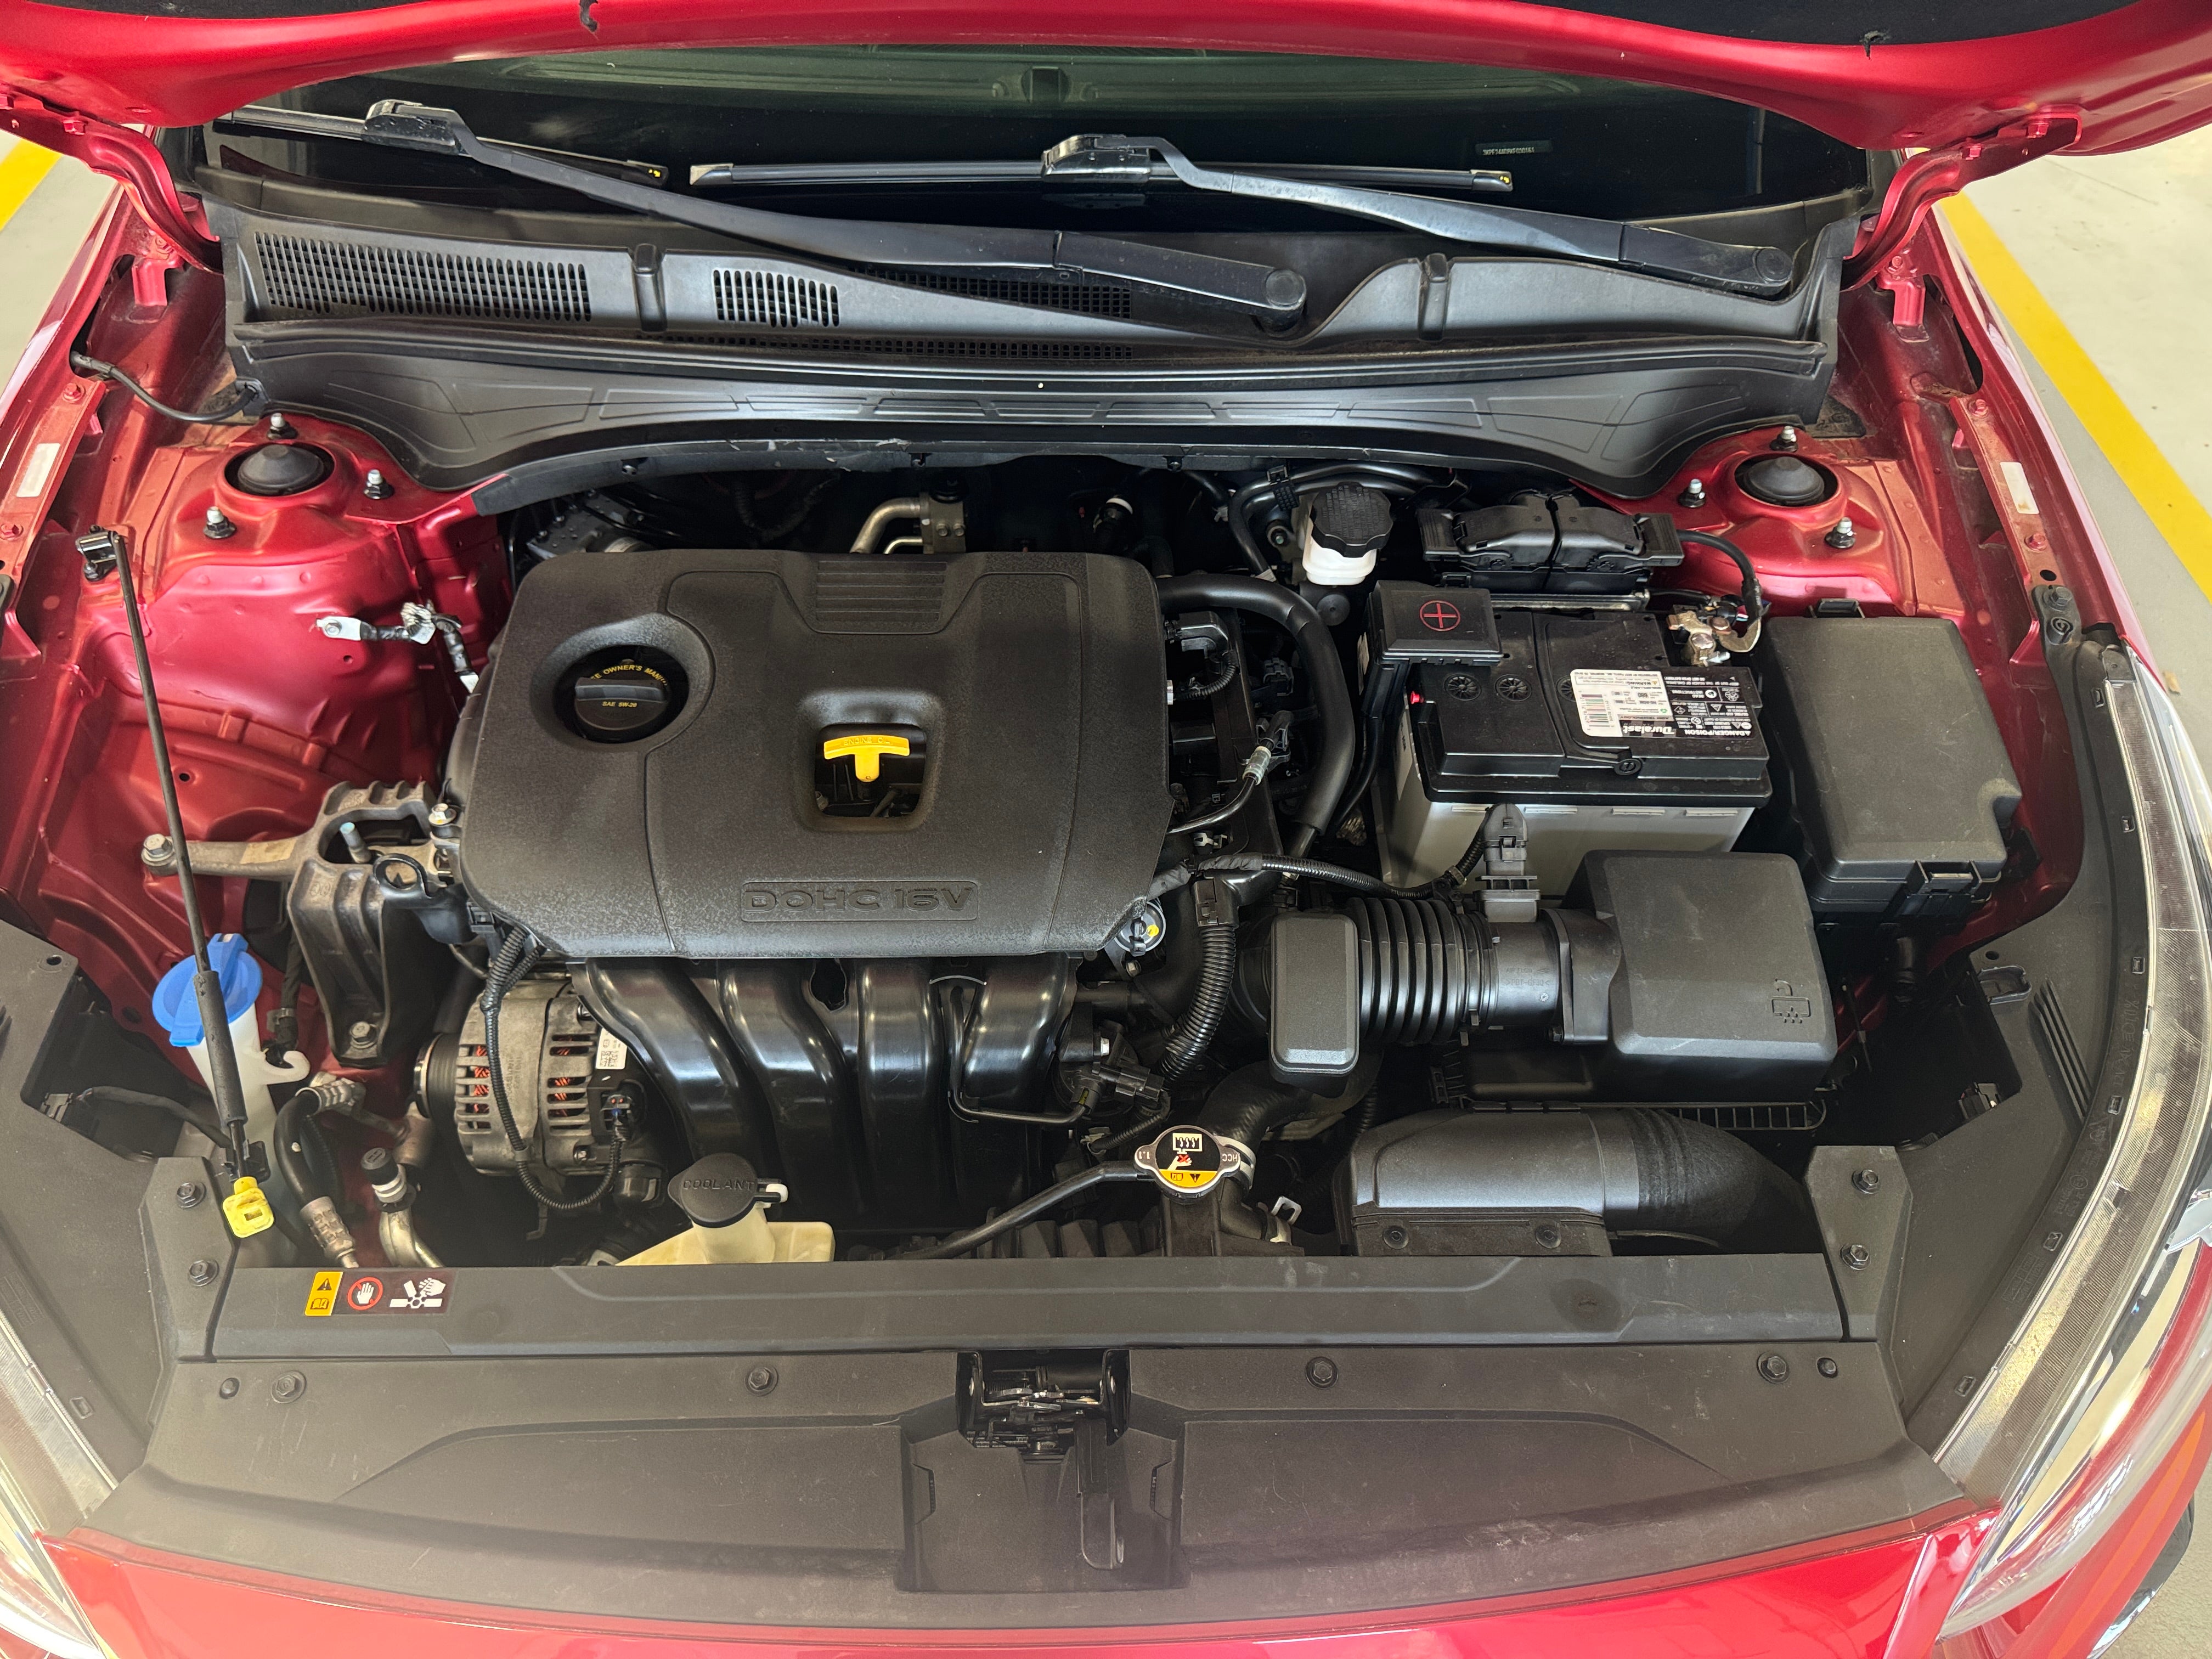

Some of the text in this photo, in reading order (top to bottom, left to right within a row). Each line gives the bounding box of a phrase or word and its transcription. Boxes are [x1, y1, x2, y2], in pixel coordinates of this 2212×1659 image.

[603, 664, 643, 675] OWNER'S
[1623, 725, 1675, 735] Duralast
[843, 737, 873, 746] ENGINE
[745, 889, 973, 912] DOHC 16V
[1222, 1154, 1238, 1163] HCC
[683, 1178, 755, 1192] COOLANT
